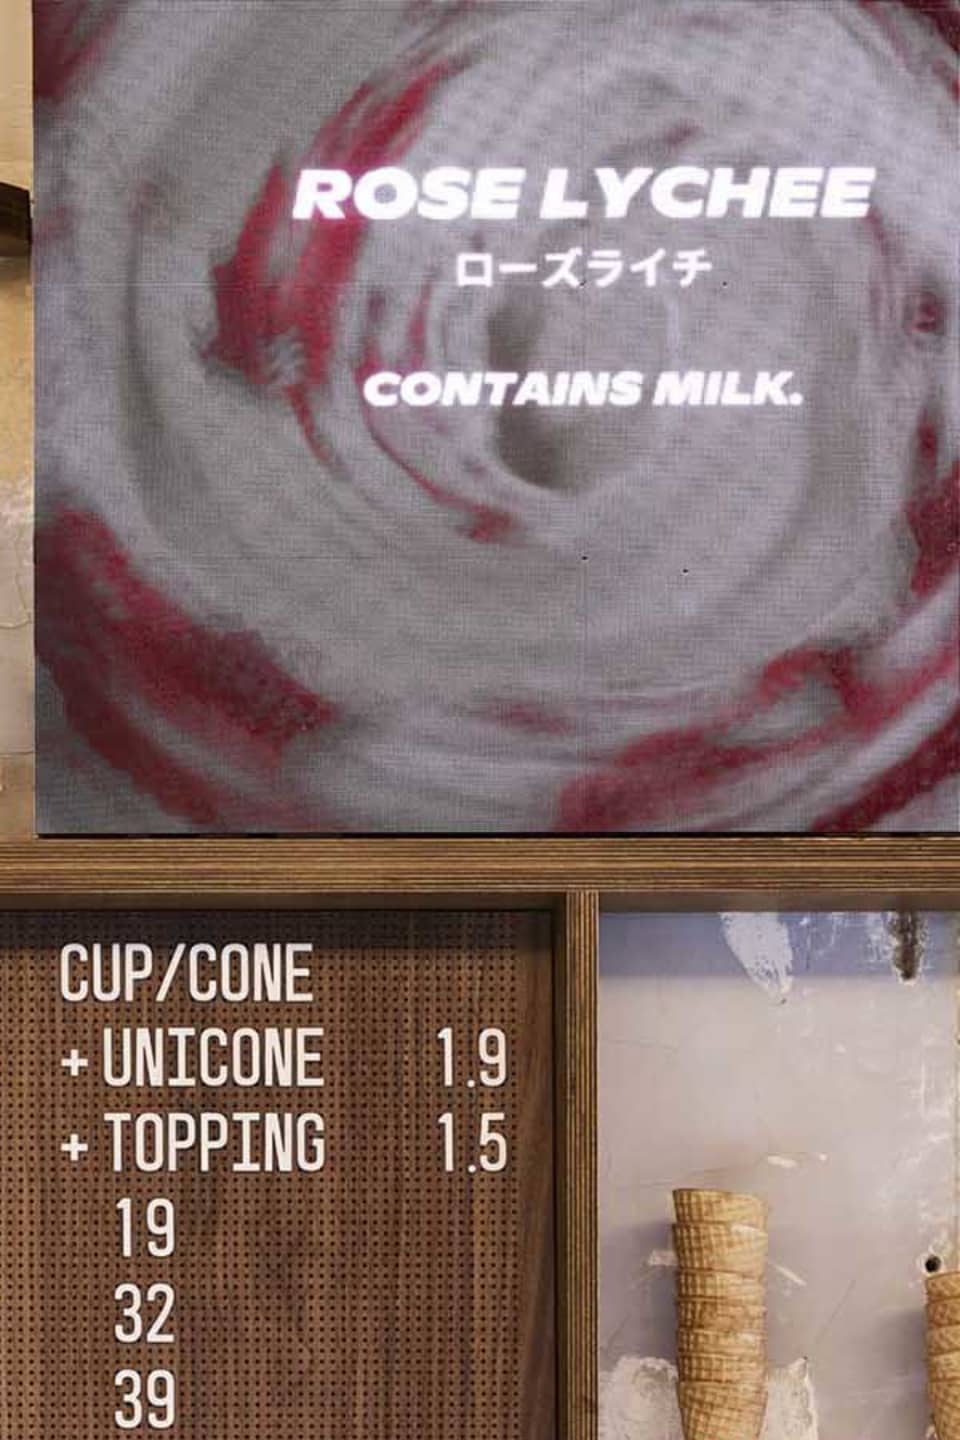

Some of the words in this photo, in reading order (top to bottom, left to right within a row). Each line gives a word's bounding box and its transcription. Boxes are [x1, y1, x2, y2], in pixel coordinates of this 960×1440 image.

[292, 166, 526, 220] ROSE
[540, 166, 876, 219] LYCHEE
[456, 247, 713, 289] ローズライチ
[364, 370, 644, 407] CONTAINS
[653, 370, 803, 406] MILK.
[60, 943, 314, 1002] CUP/CONE
[103, 1028, 325, 1087] UNICONE
[437, 1028, 506, 1088] 1.9
[103, 1113, 325, 1172] TOPPING
[438, 1113, 507, 1173] 1.5
[116, 1198, 175, 1257] 19
[114, 1283, 175, 1343] 32
[114, 1369, 175, 1429] 39
